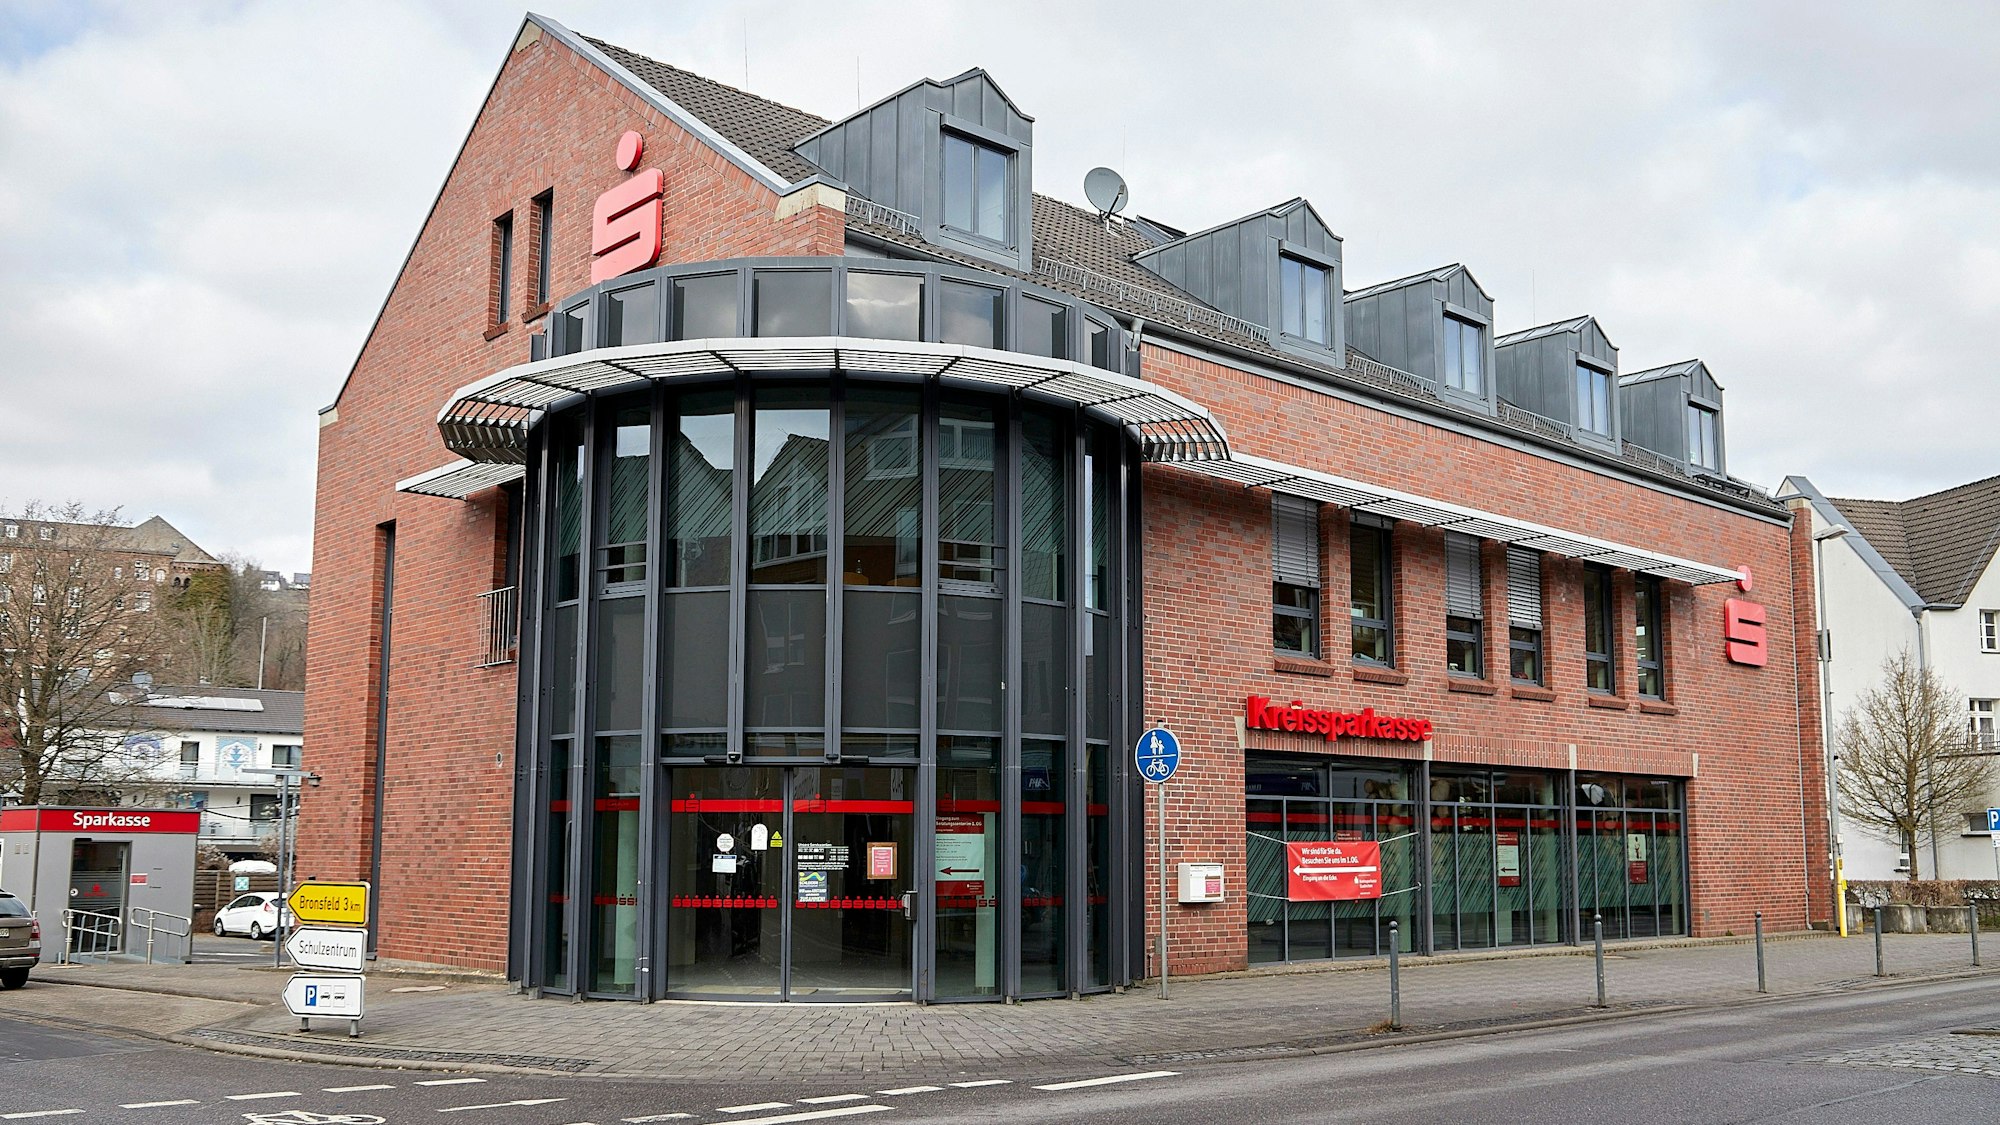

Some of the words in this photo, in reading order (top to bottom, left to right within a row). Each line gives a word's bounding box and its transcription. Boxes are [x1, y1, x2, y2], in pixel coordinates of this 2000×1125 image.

[1247, 696, 1433, 741] Kreissparkasse
[73, 811, 151, 829] Sparkasse
[1990, 811, 1999, 829] P
[1310, 847, 1320, 855] sind
[299, 895, 340, 911] Bronsfeld
[343, 897, 349, 911] 3
[350, 901, 361, 912] km
[298, 940, 357, 958] Schulzentrum
[307, 987, 316, 1005] P
